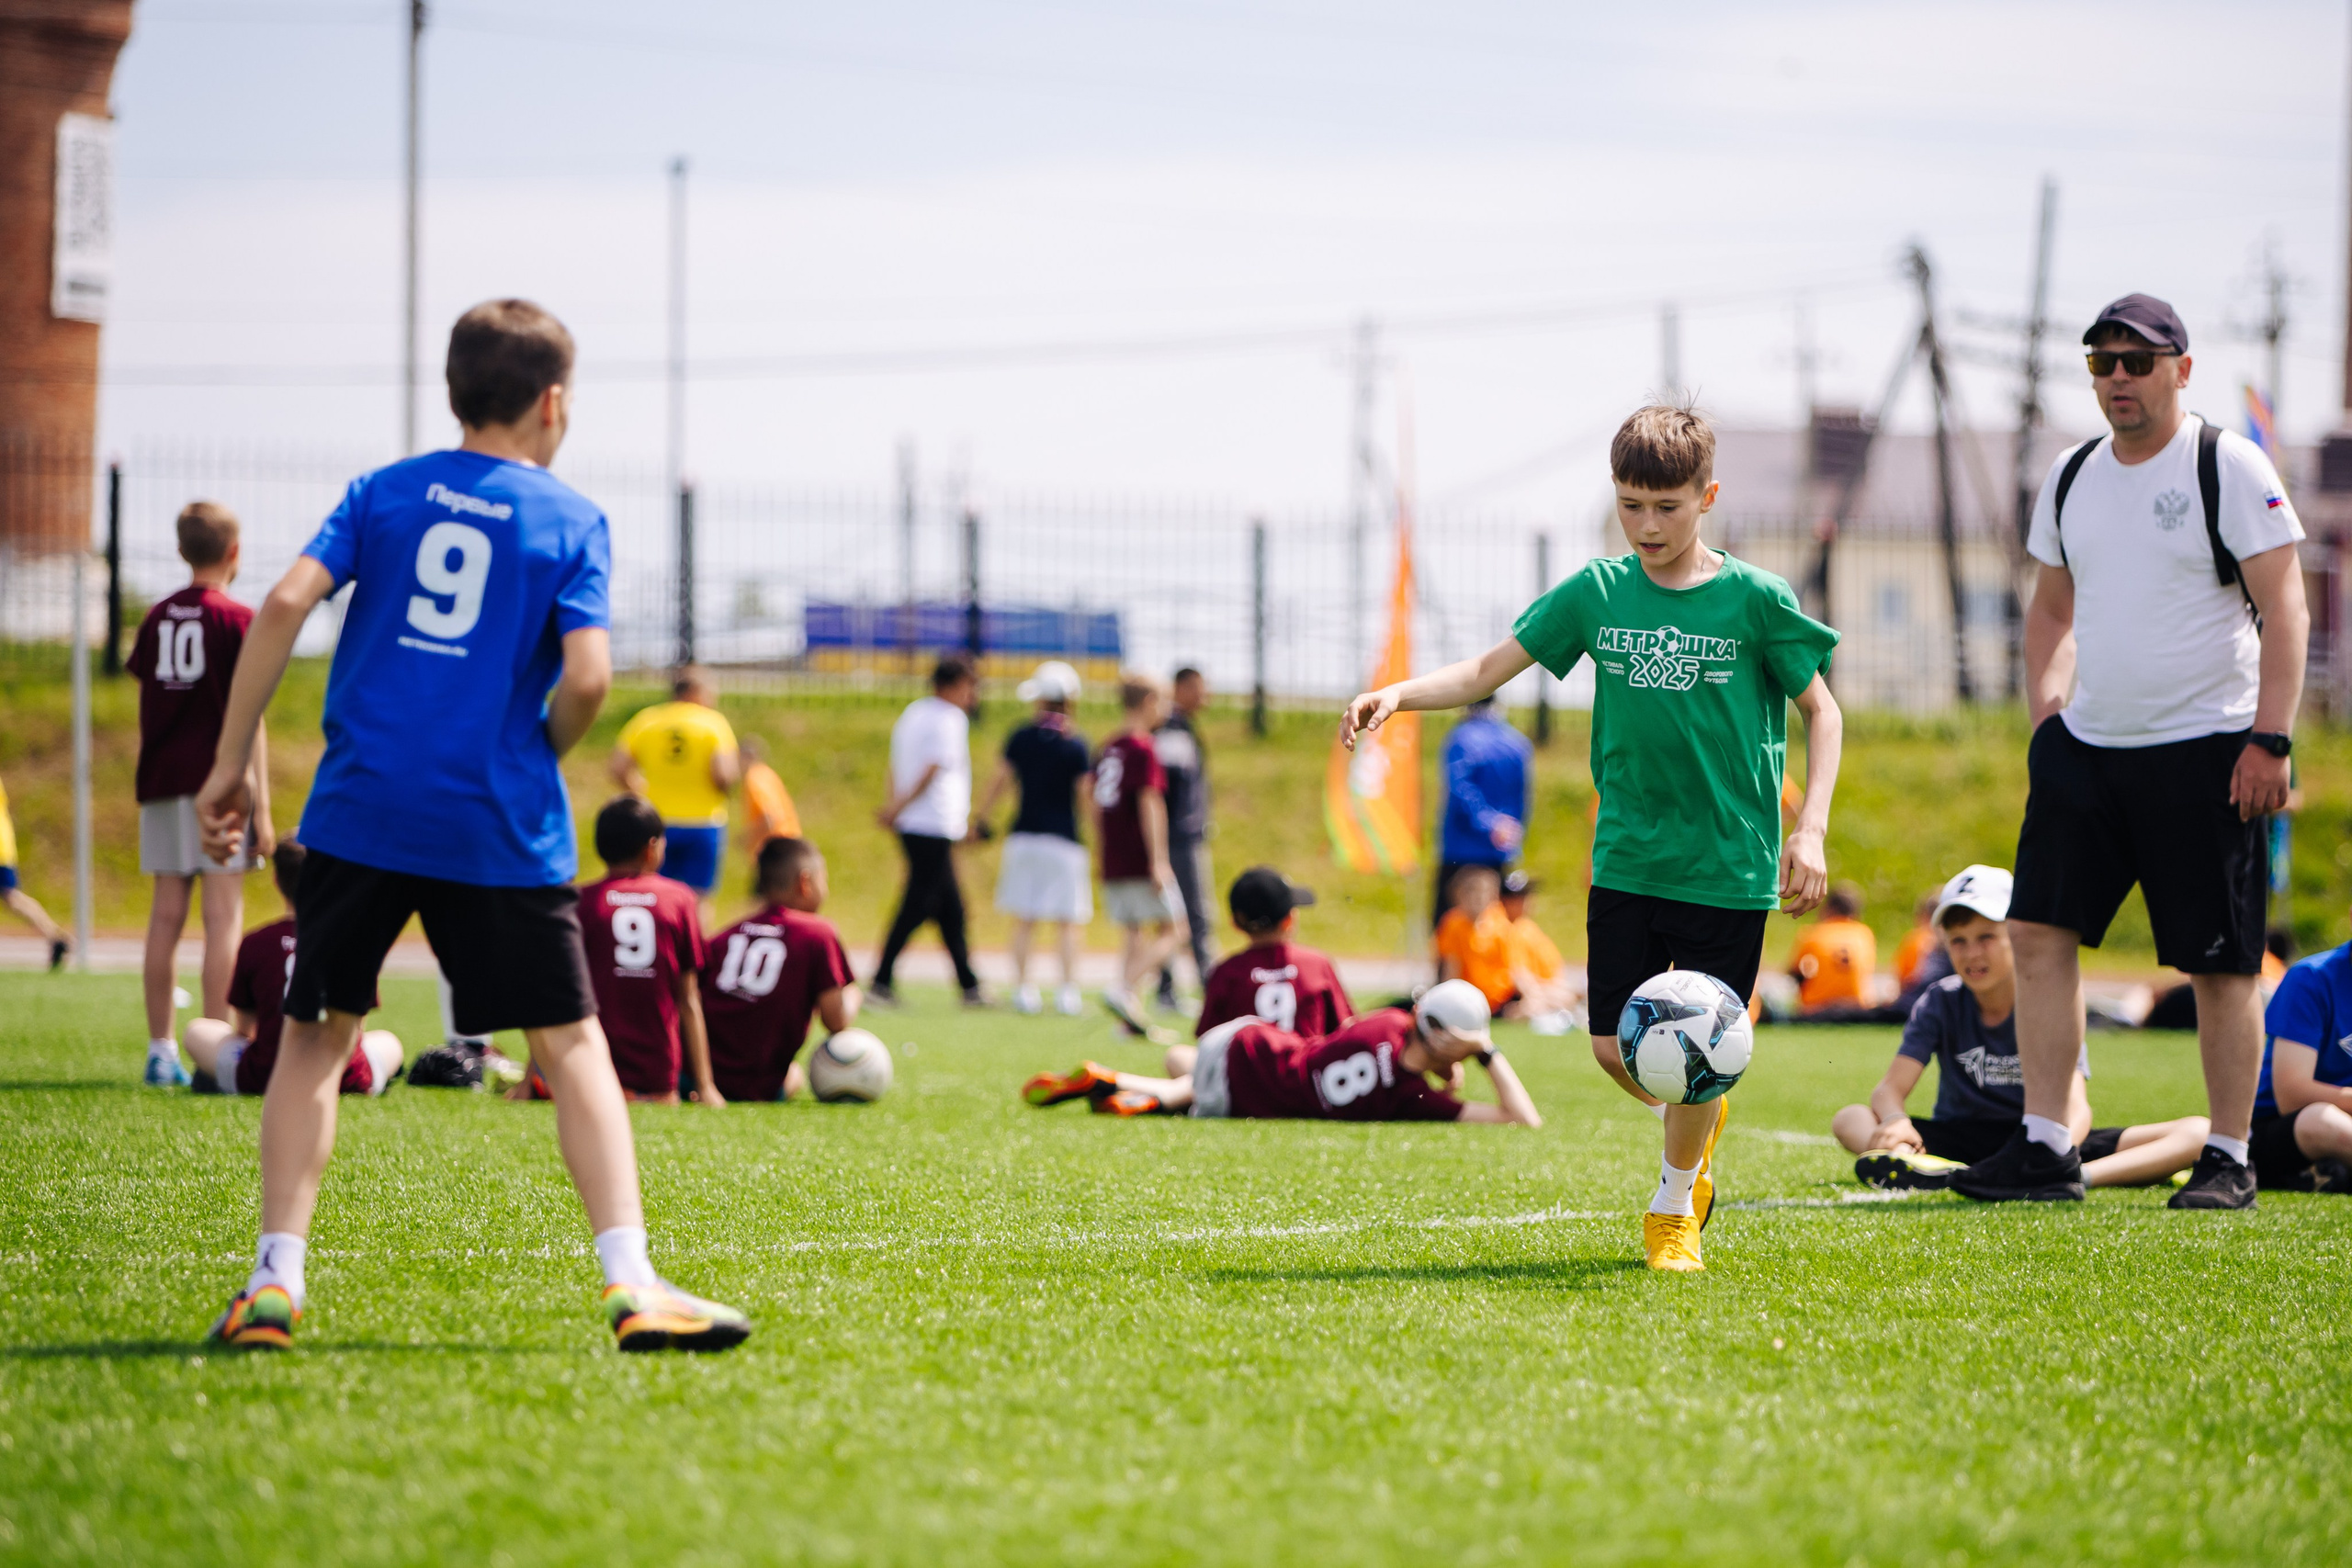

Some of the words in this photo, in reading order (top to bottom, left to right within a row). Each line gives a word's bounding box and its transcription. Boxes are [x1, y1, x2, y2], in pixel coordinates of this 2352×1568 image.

[425, 482, 514, 521] Первые
[406, 521, 492, 639] 9
[154, 619, 206, 682] 10
[1597, 626, 1736, 660] МЕТРОШКА
[1629, 654, 1701, 691] 2025
[612, 906, 656, 968] 9
[716, 933, 787, 997] 10
[1254, 982, 1296, 1032] 9
[1321, 1051, 1378, 1106] 8
